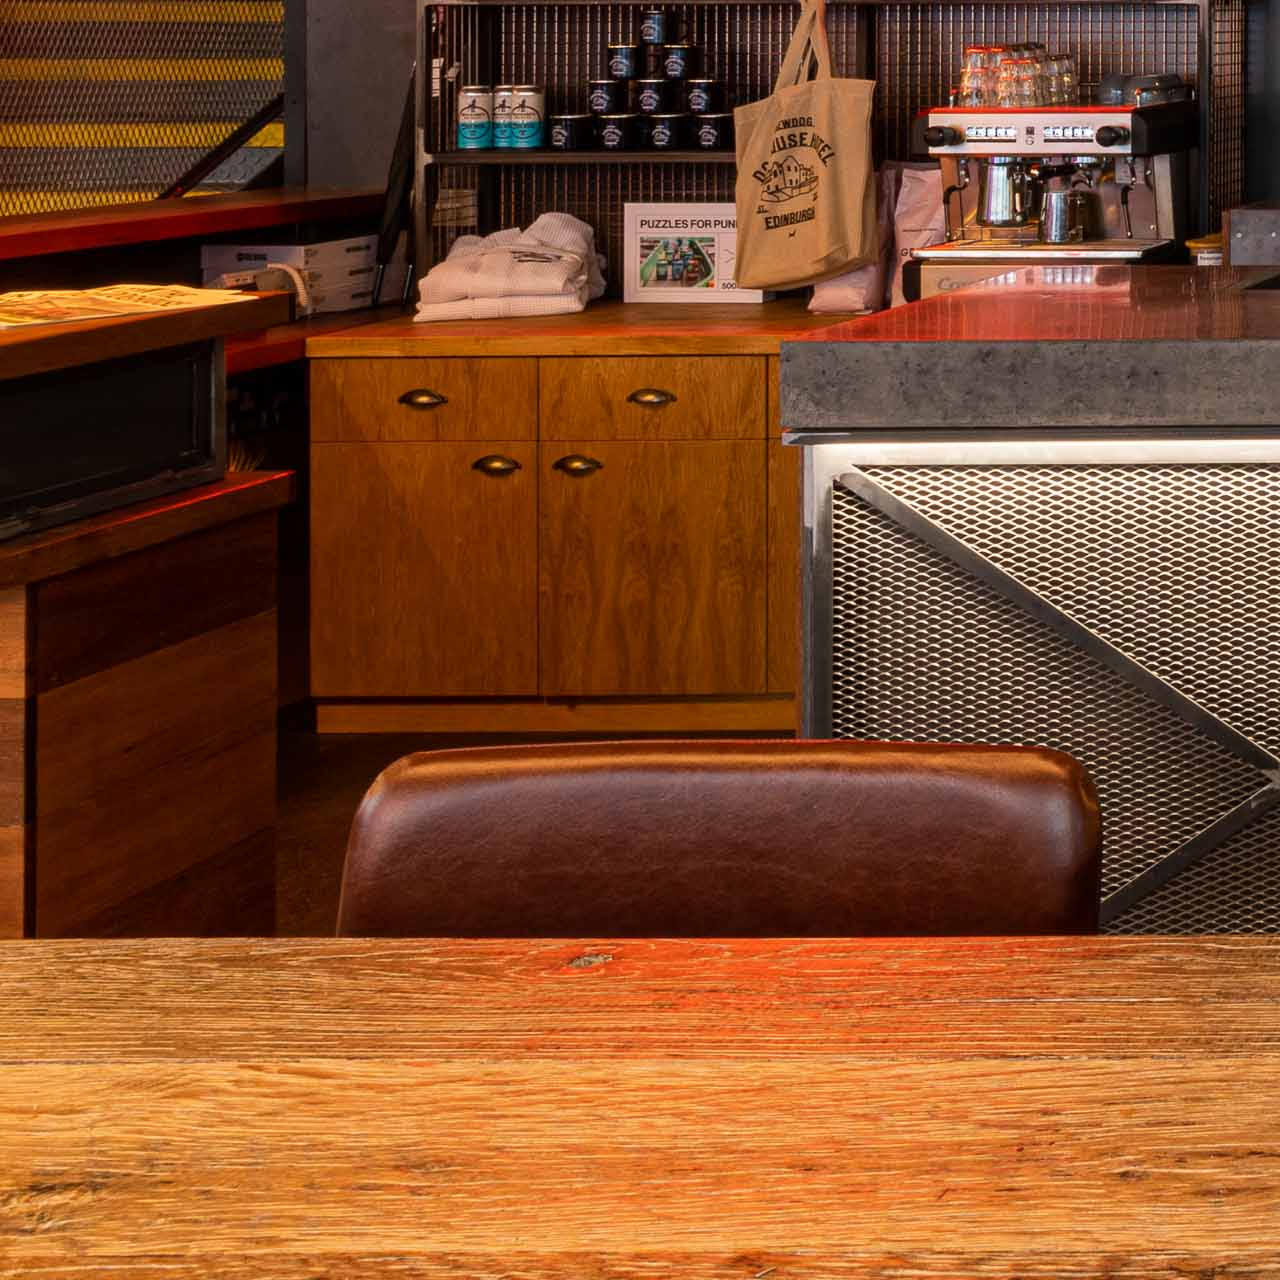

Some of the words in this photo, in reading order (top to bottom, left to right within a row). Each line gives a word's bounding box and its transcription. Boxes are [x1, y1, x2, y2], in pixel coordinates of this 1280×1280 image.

[640, 219, 689, 229] PUZZLES
[690, 219, 712, 229] FOR
[713, 219, 737, 229] PUN
